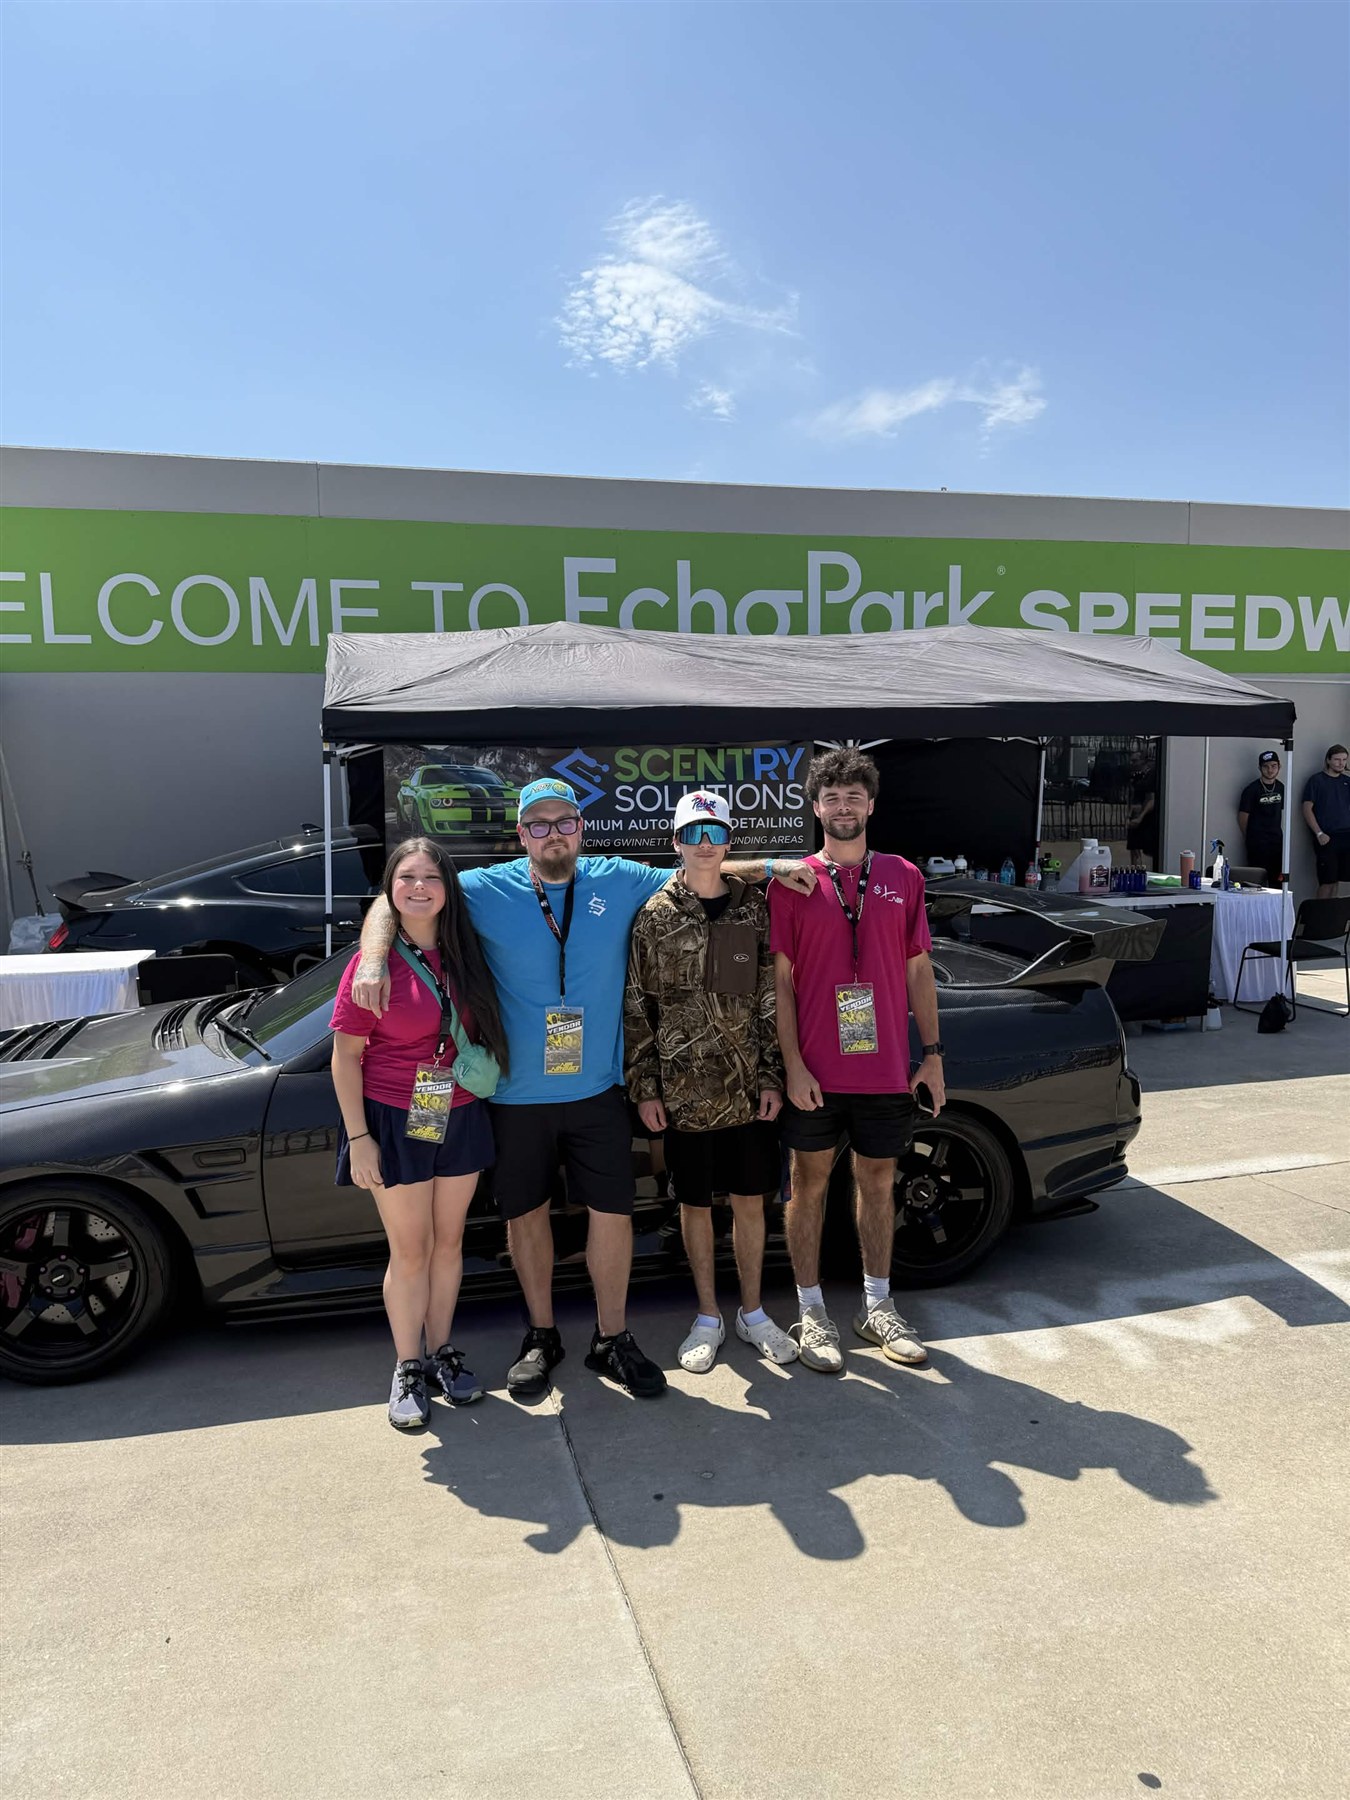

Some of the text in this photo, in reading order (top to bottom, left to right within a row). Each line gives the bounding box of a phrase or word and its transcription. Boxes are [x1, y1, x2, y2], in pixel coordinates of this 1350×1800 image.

[411, 581, 530, 633] TO
[563, 551, 995, 635] EchoPark
[613, 747, 806, 783] SCENTRY
[614, 783, 804, 812] SOLTIONS
[613, 837, 669, 847] GWINNETT
[769, 835, 804, 845] AREAS
[840, 996, 872, 1012] VENDOR
[548, 1020, 581, 1034] VENDOR
[416, 1082, 452, 1093] VENDOR
